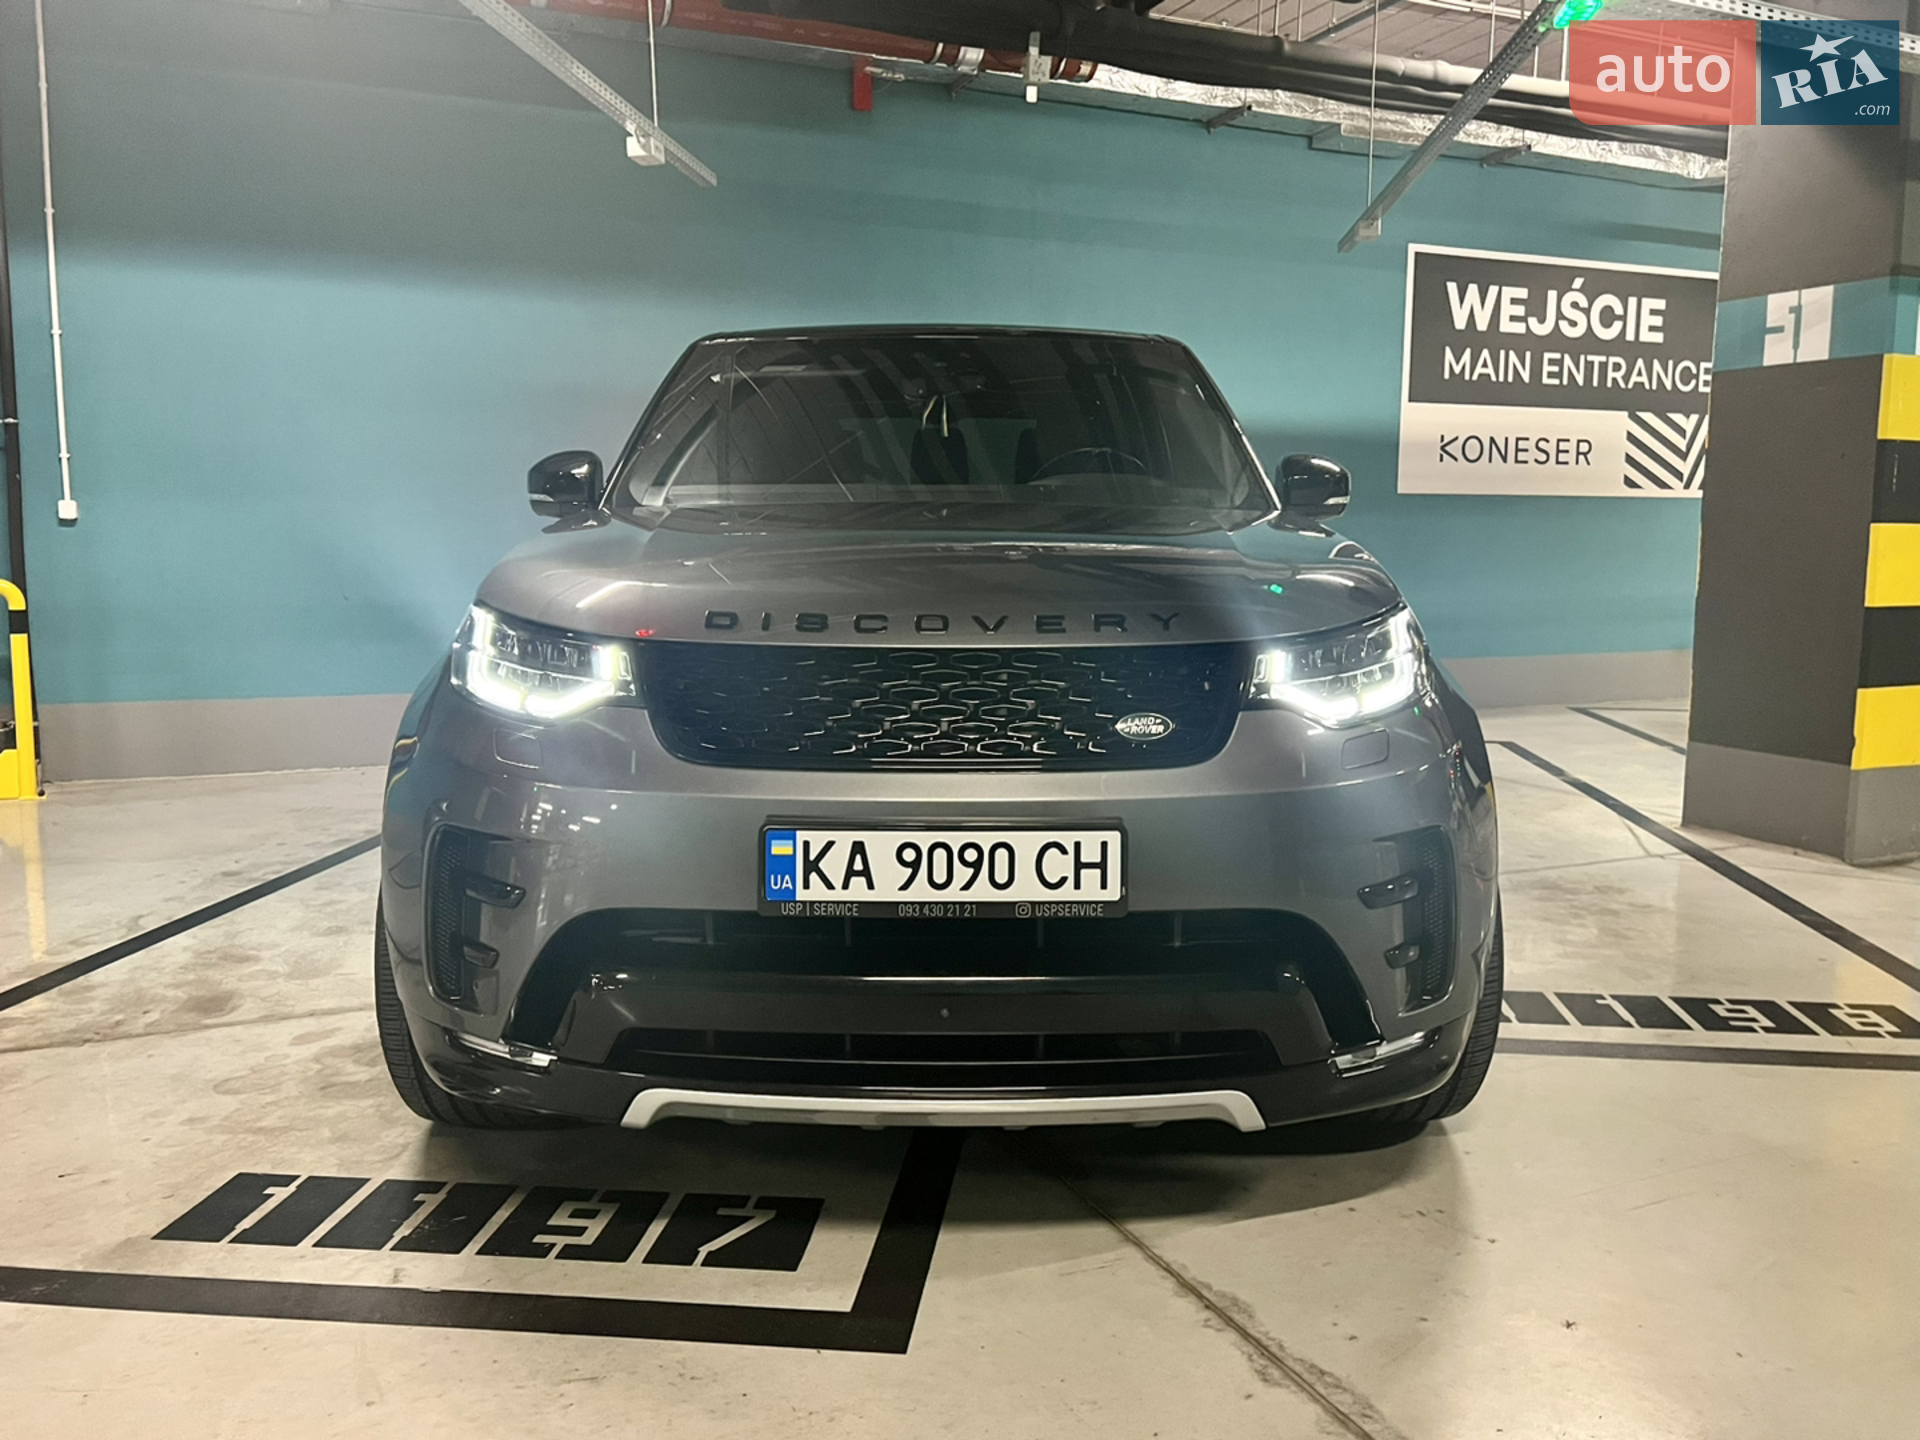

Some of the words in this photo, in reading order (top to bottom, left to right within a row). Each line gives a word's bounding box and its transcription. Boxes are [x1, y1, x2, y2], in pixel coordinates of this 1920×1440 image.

[1445, 277, 1667, 343] WEJŚCIE
[1443, 345, 1531, 384] MAIN
[1541, 351, 1713, 393] ENTRANCE
[1439, 434, 1593, 466] KONESER
[704, 609, 1181, 635] DISCOVERY
[1127, 716, 1155, 726] LAND
[1130, 724, 1165, 735] ROVER
[802, 840, 876, 891] KA
[895, 841, 1016, 891] 9090
[1035, 840, 1108, 891] CH
[770, 874, 793, 891] UA
[781, 902, 803, 916] USP
[813, 903, 859, 916] SERVICE
[898, 903, 919, 917] 093
[922, 903, 943, 917] 430
[947, 903, 960, 917] 21
[963, 903, 977, 917] 21
[1035, 903, 1104, 917] USPSERVICE
[222, 1176, 778, 1265] 1197
